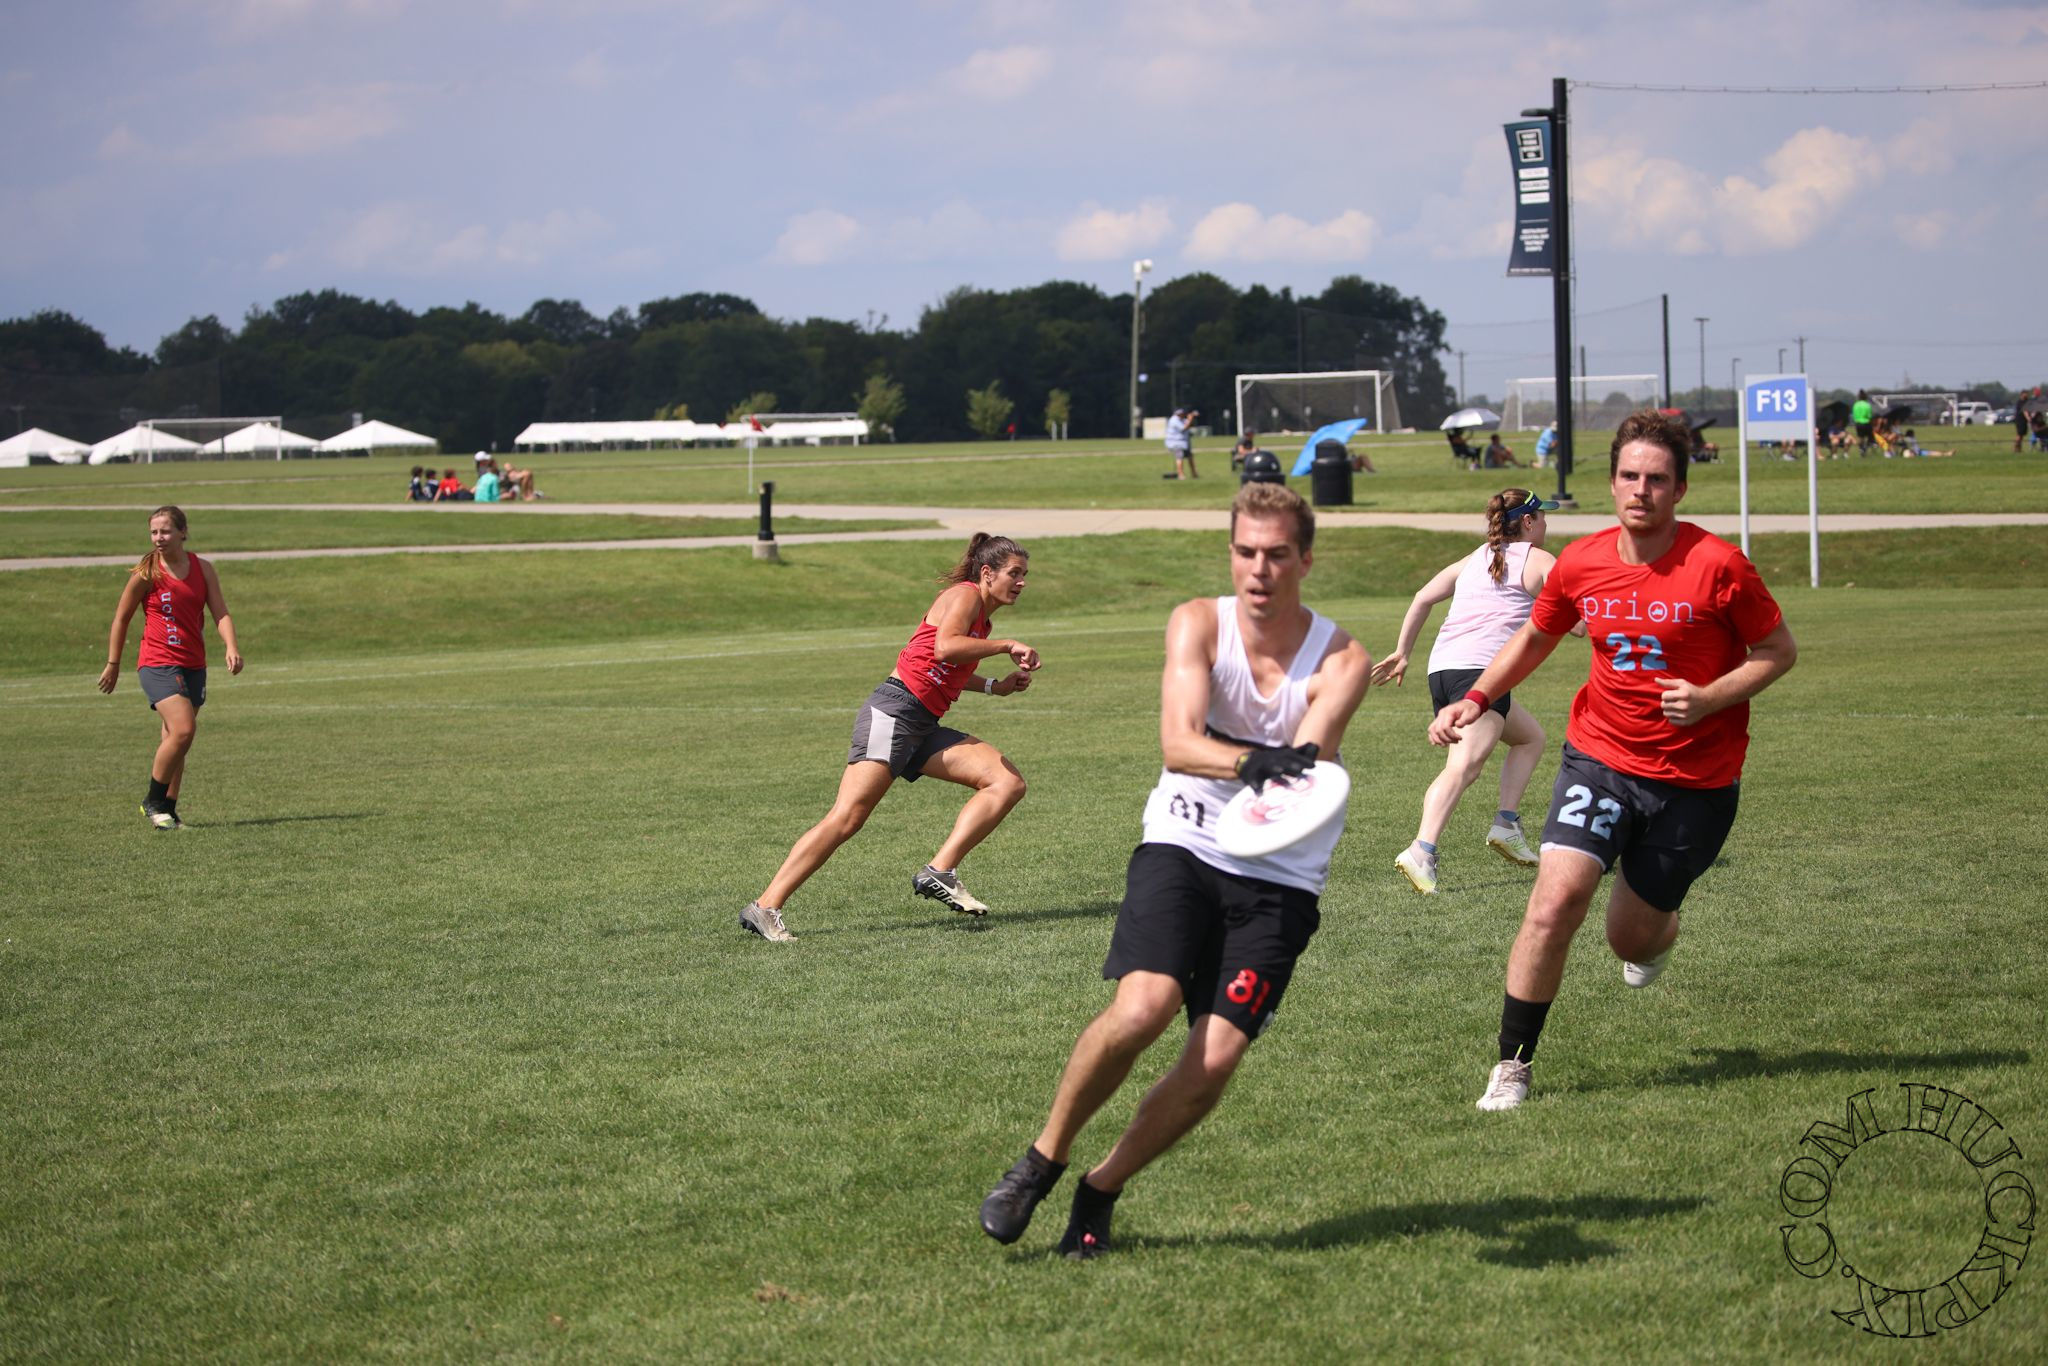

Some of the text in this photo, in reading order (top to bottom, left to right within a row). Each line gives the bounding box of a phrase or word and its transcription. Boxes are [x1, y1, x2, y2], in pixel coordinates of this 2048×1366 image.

[1755, 389, 1798, 413] F13
[161, 591, 182, 646] prion
[1582, 591, 1694, 624] prion
[1606, 632, 1668, 671] 22
[1557, 784, 1623, 841] 22
[1226, 968, 1272, 1015] 81
